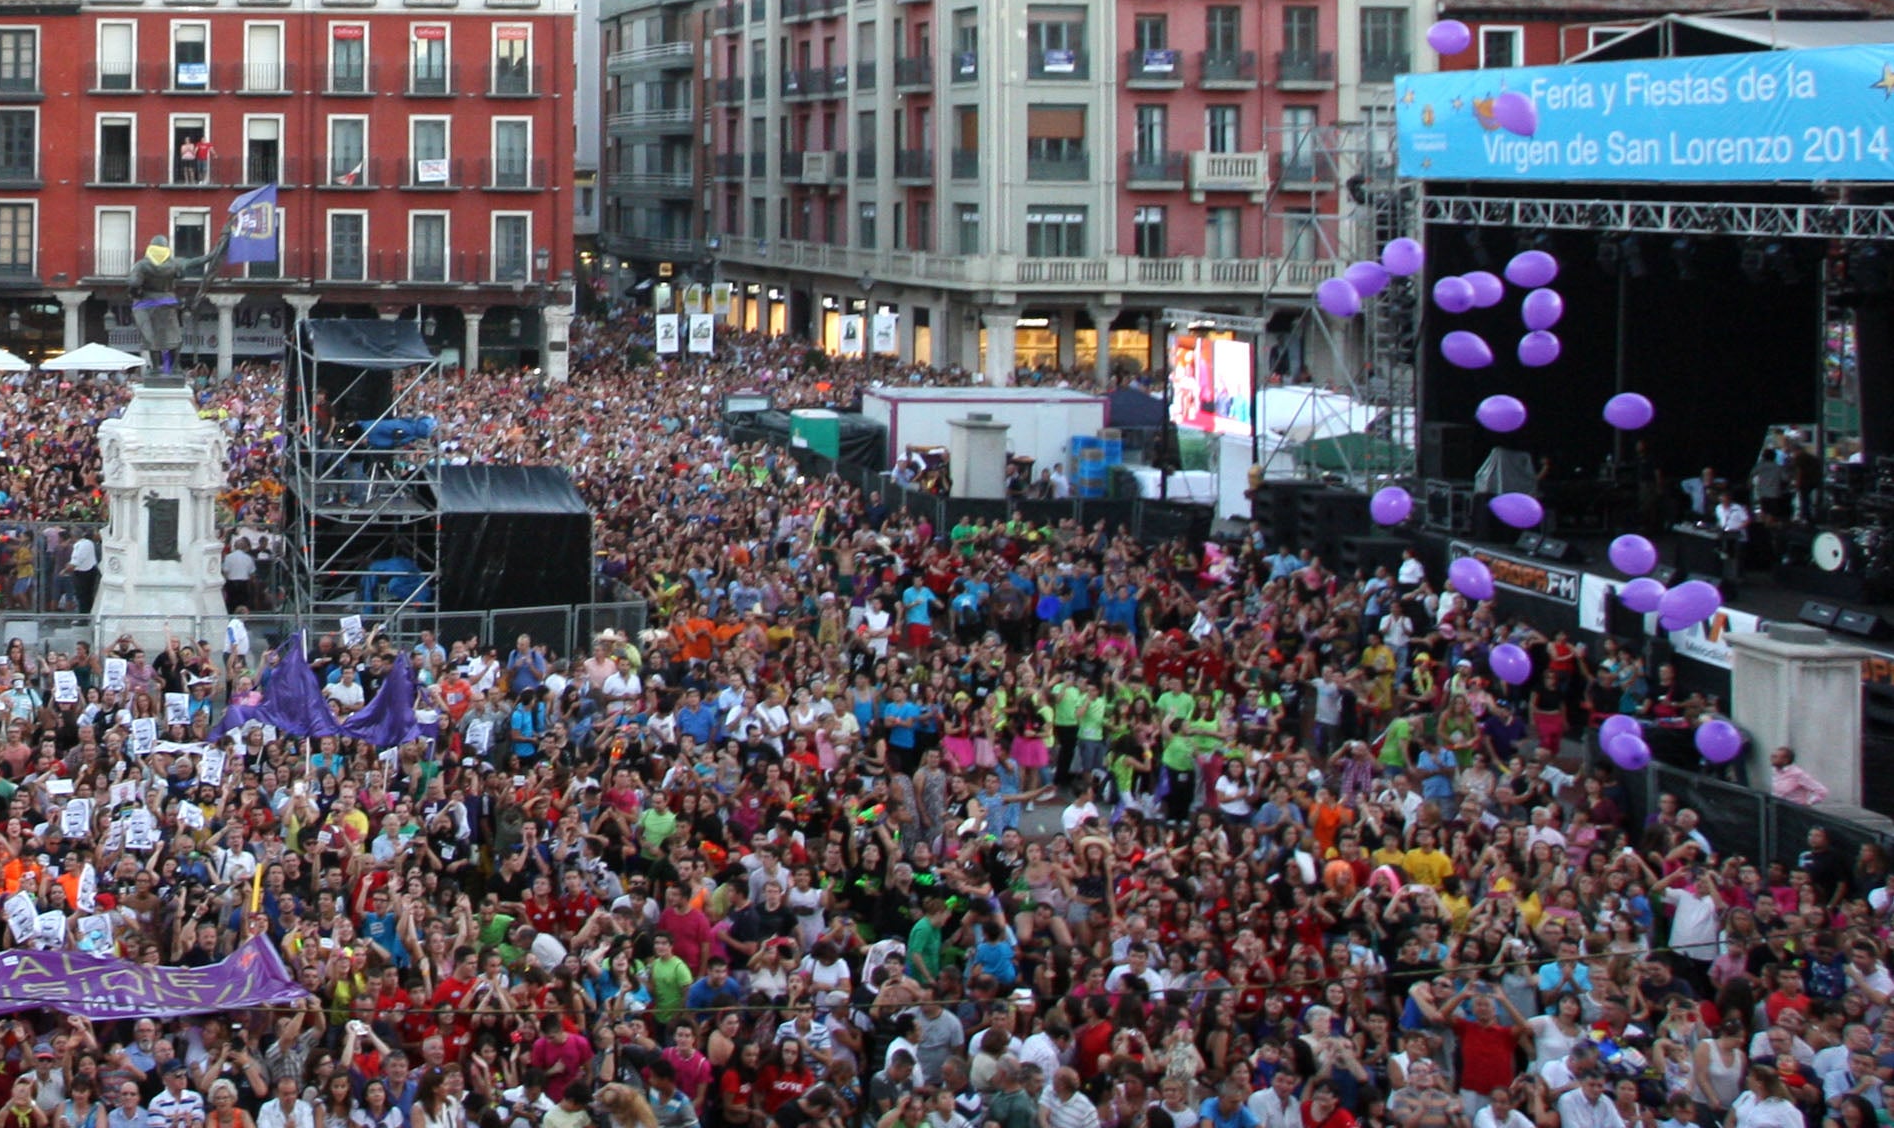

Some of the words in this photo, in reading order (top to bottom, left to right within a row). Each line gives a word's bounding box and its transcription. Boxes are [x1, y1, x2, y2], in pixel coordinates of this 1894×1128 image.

[1531, 77, 1594, 109] Feria
[1601, 82, 1618, 115] y
[1625, 71, 1728, 108] Fiestas
[1736, 65, 1777, 102] de
[1786, 61, 1817, 98] la
[1482, 132, 1560, 172] Virgen
[1565, 131, 1599, 165] de
[1607, 129, 1659, 165] San
[1669, 130, 1794, 166] Lorenzo
[1802, 124, 1890, 162] 2014
